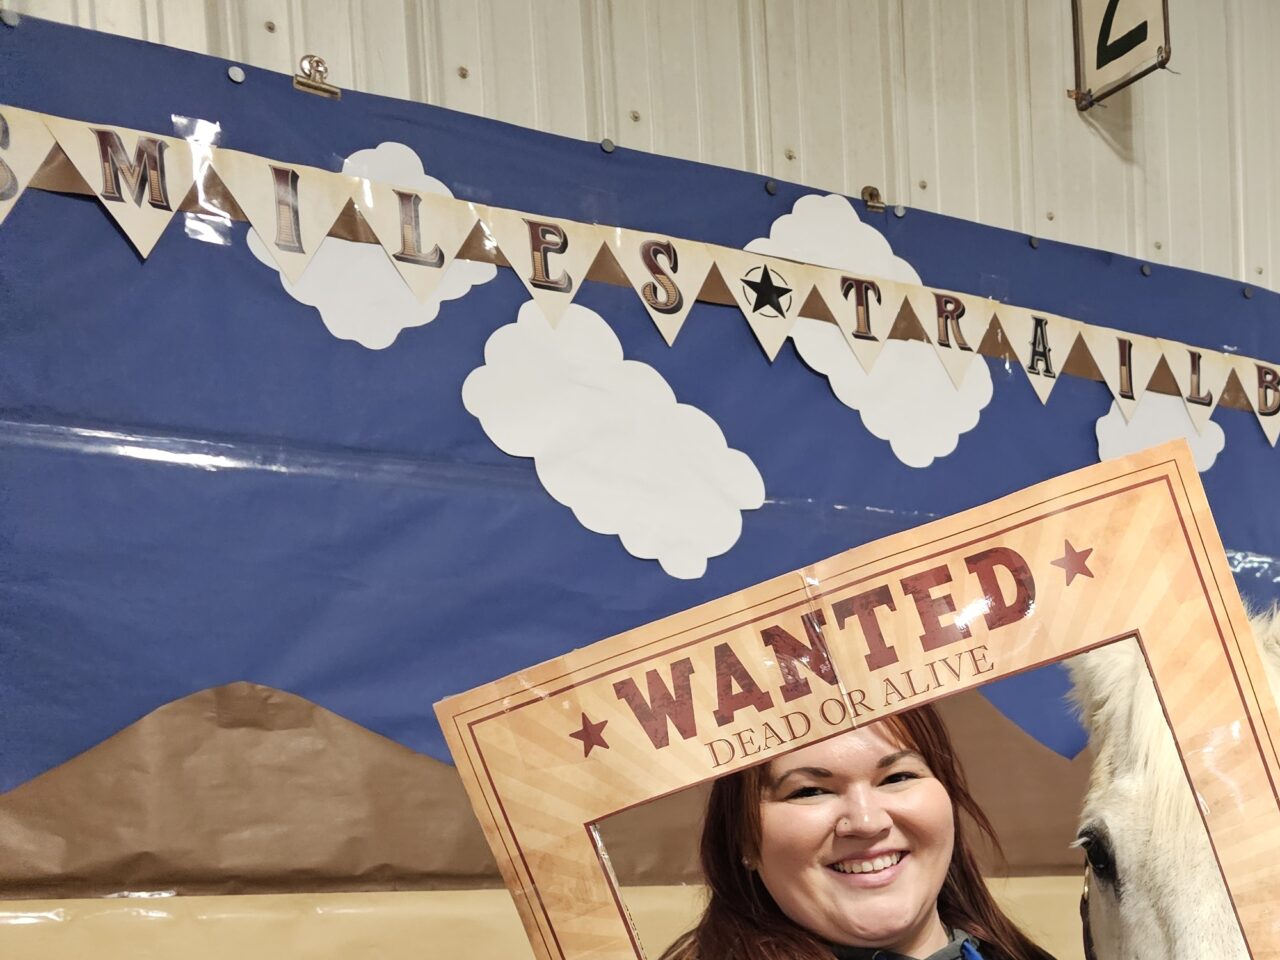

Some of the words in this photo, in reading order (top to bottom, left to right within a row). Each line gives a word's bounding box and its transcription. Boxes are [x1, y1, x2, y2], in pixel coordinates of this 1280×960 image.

[612, 546, 1036, 750] WANTED
[704, 710, 812, 768] DEAD
[819, 688, 874, 727] OR
[882, 645, 995, 708] ALIVE
